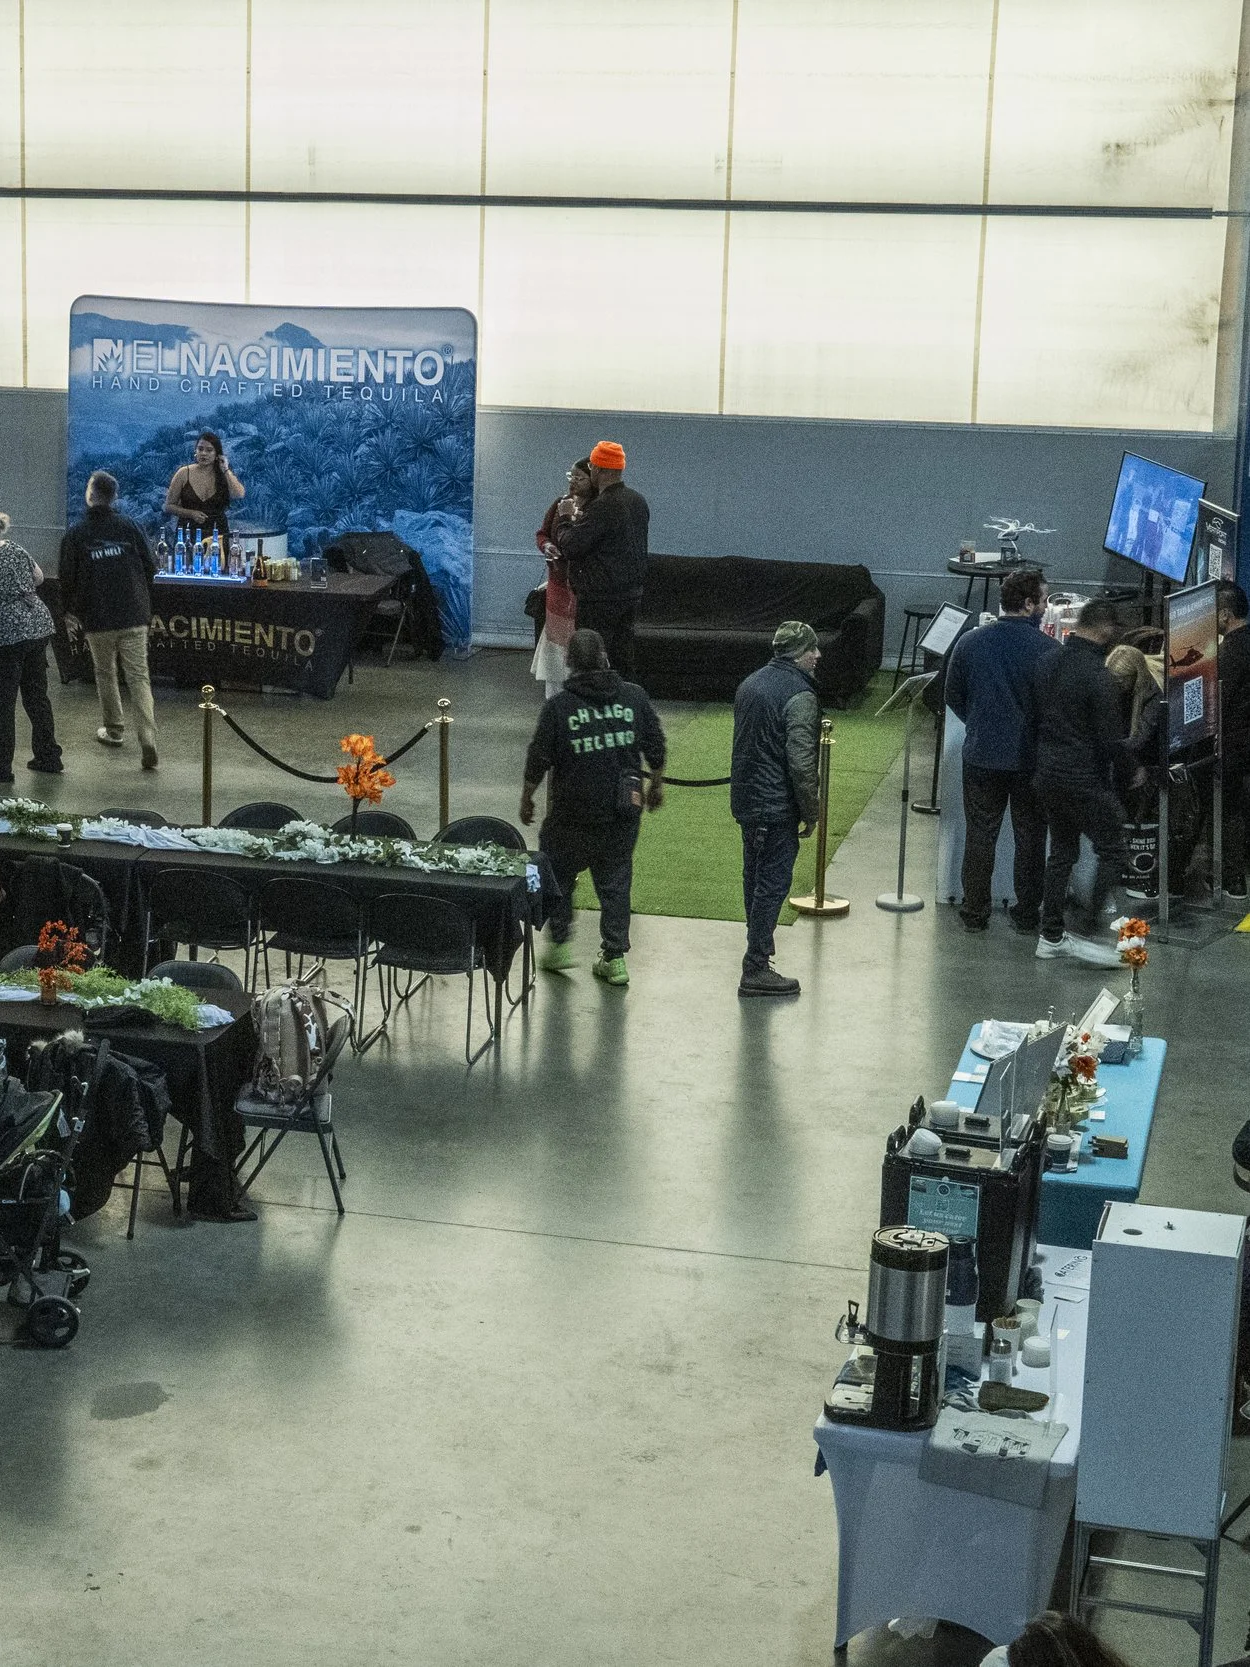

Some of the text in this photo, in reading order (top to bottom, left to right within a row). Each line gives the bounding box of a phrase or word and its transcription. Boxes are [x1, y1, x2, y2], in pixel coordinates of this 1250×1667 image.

[92, 375, 444, 403] HAND CRAFTED TEQUILA
[150, 614, 316, 657] ACIMIENTO
